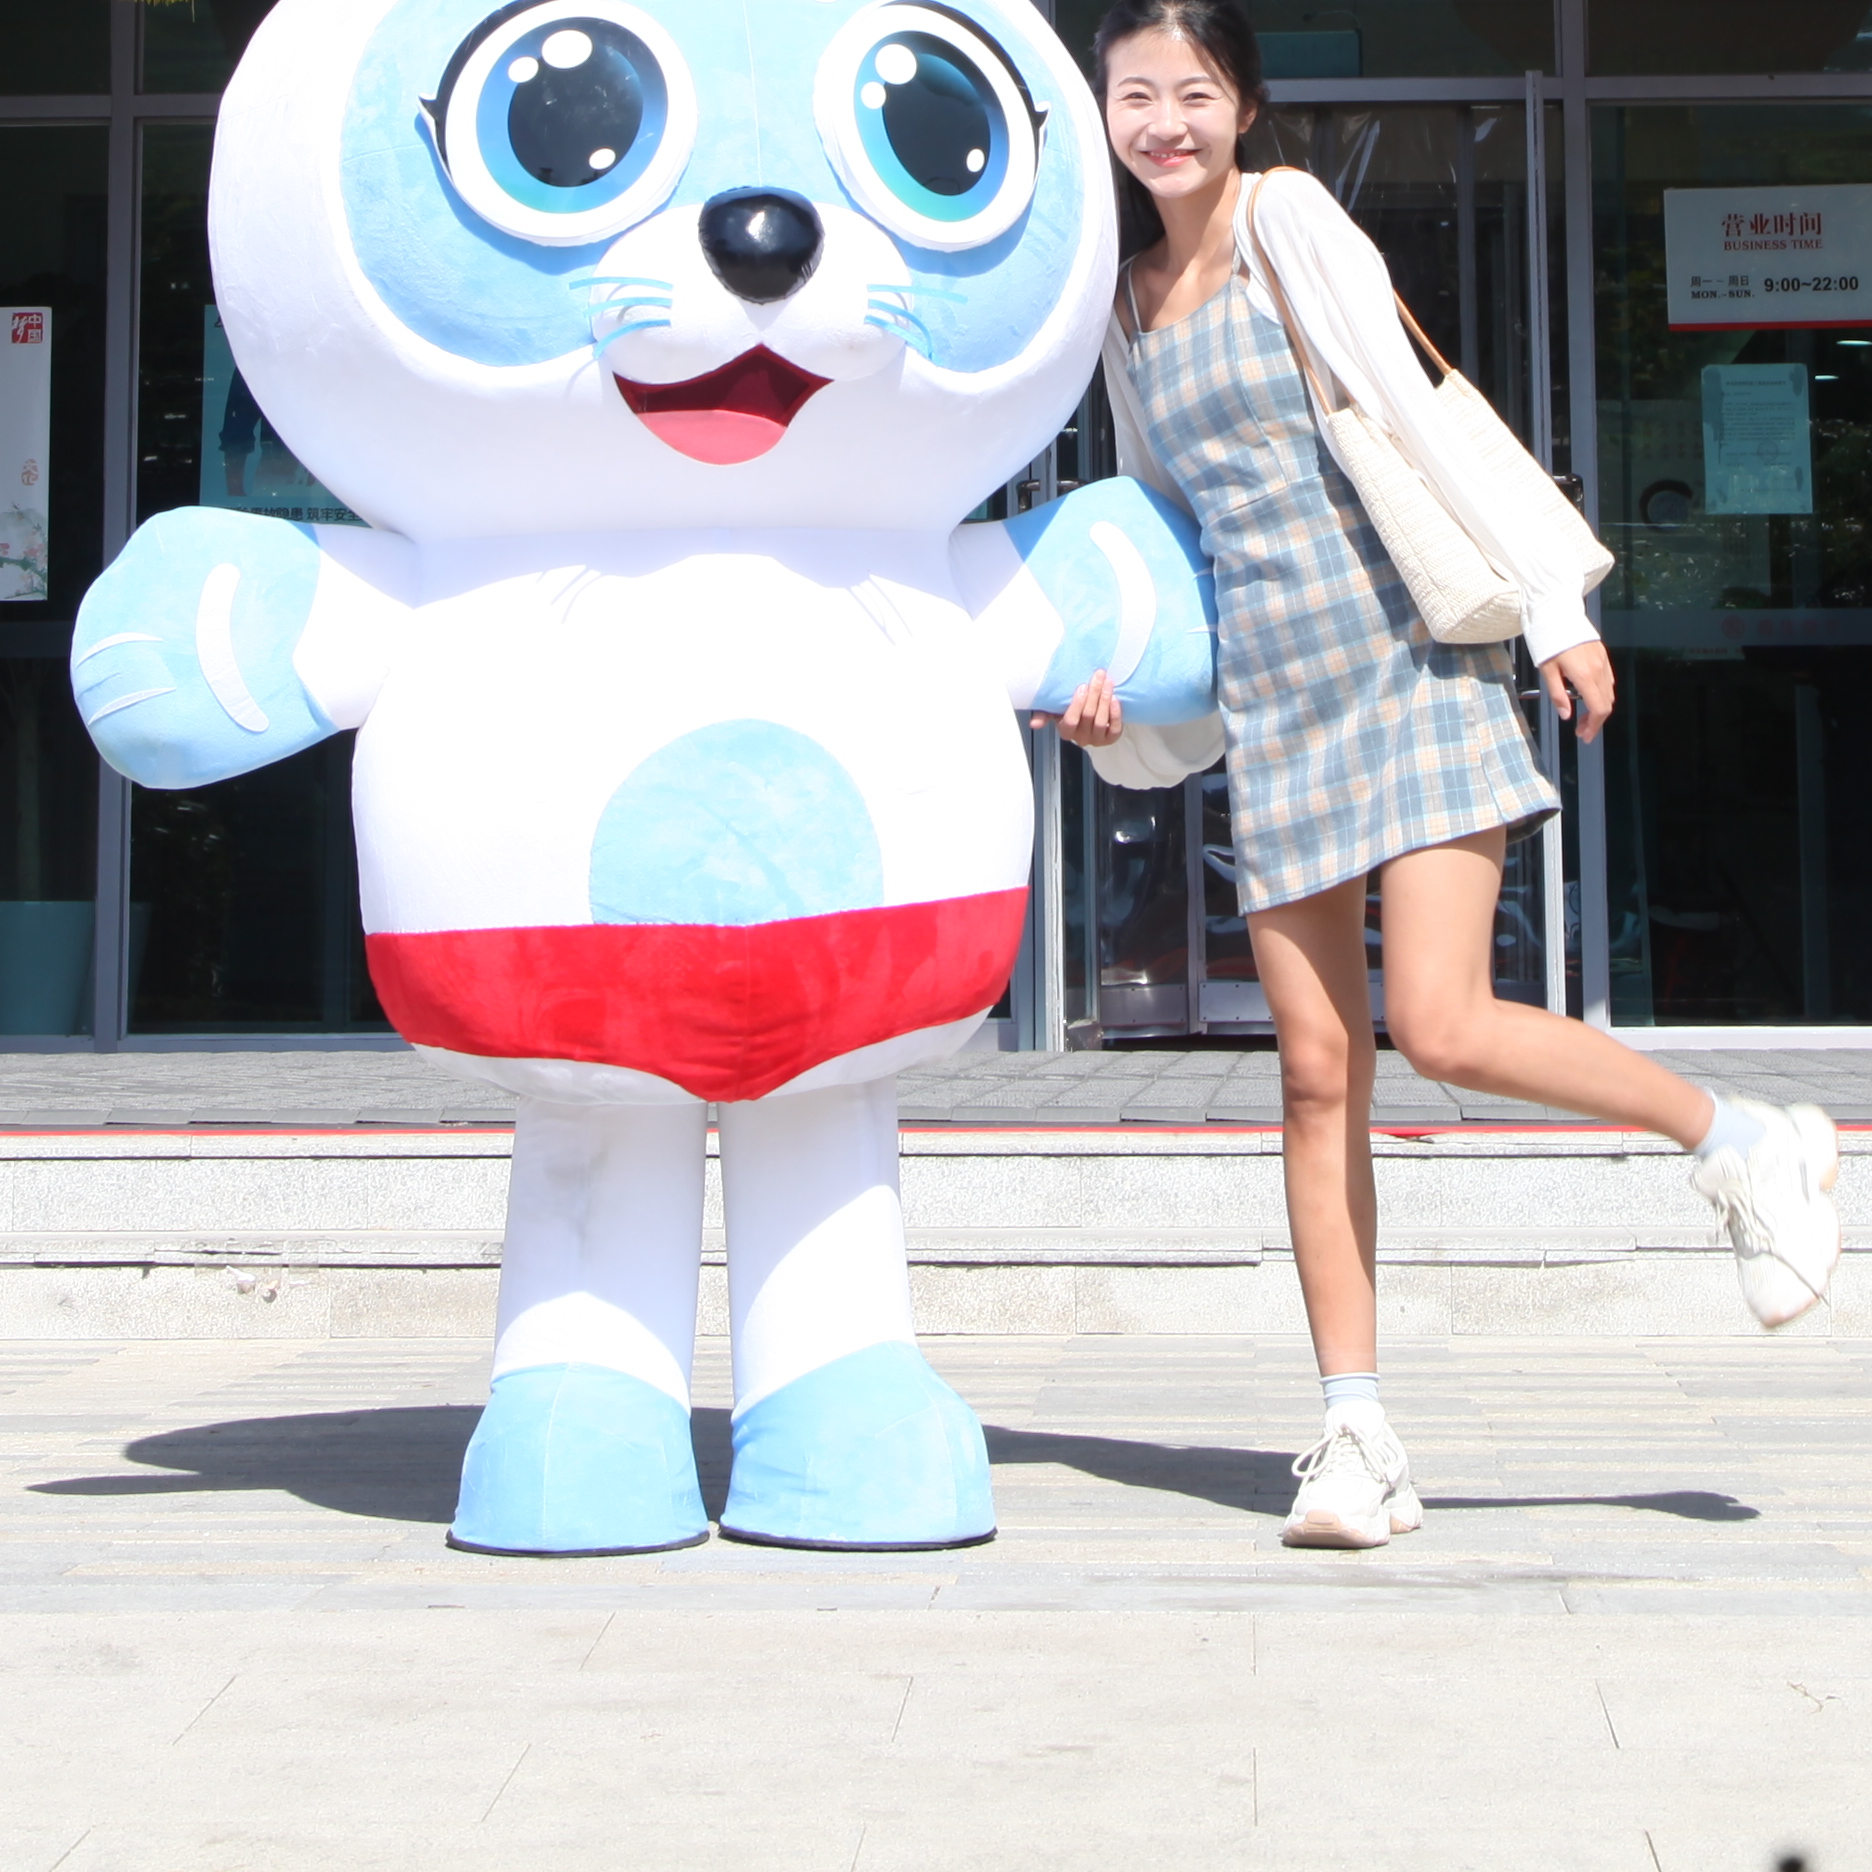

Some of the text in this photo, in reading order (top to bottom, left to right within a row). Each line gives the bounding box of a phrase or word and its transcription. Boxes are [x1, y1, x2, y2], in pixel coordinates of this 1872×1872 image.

[1721, 212, 1822, 237] 营业时间
[1724, 239, 1823, 251] BUSINESS TIME
[1763, 276, 1859, 292] 9:00~22:00
